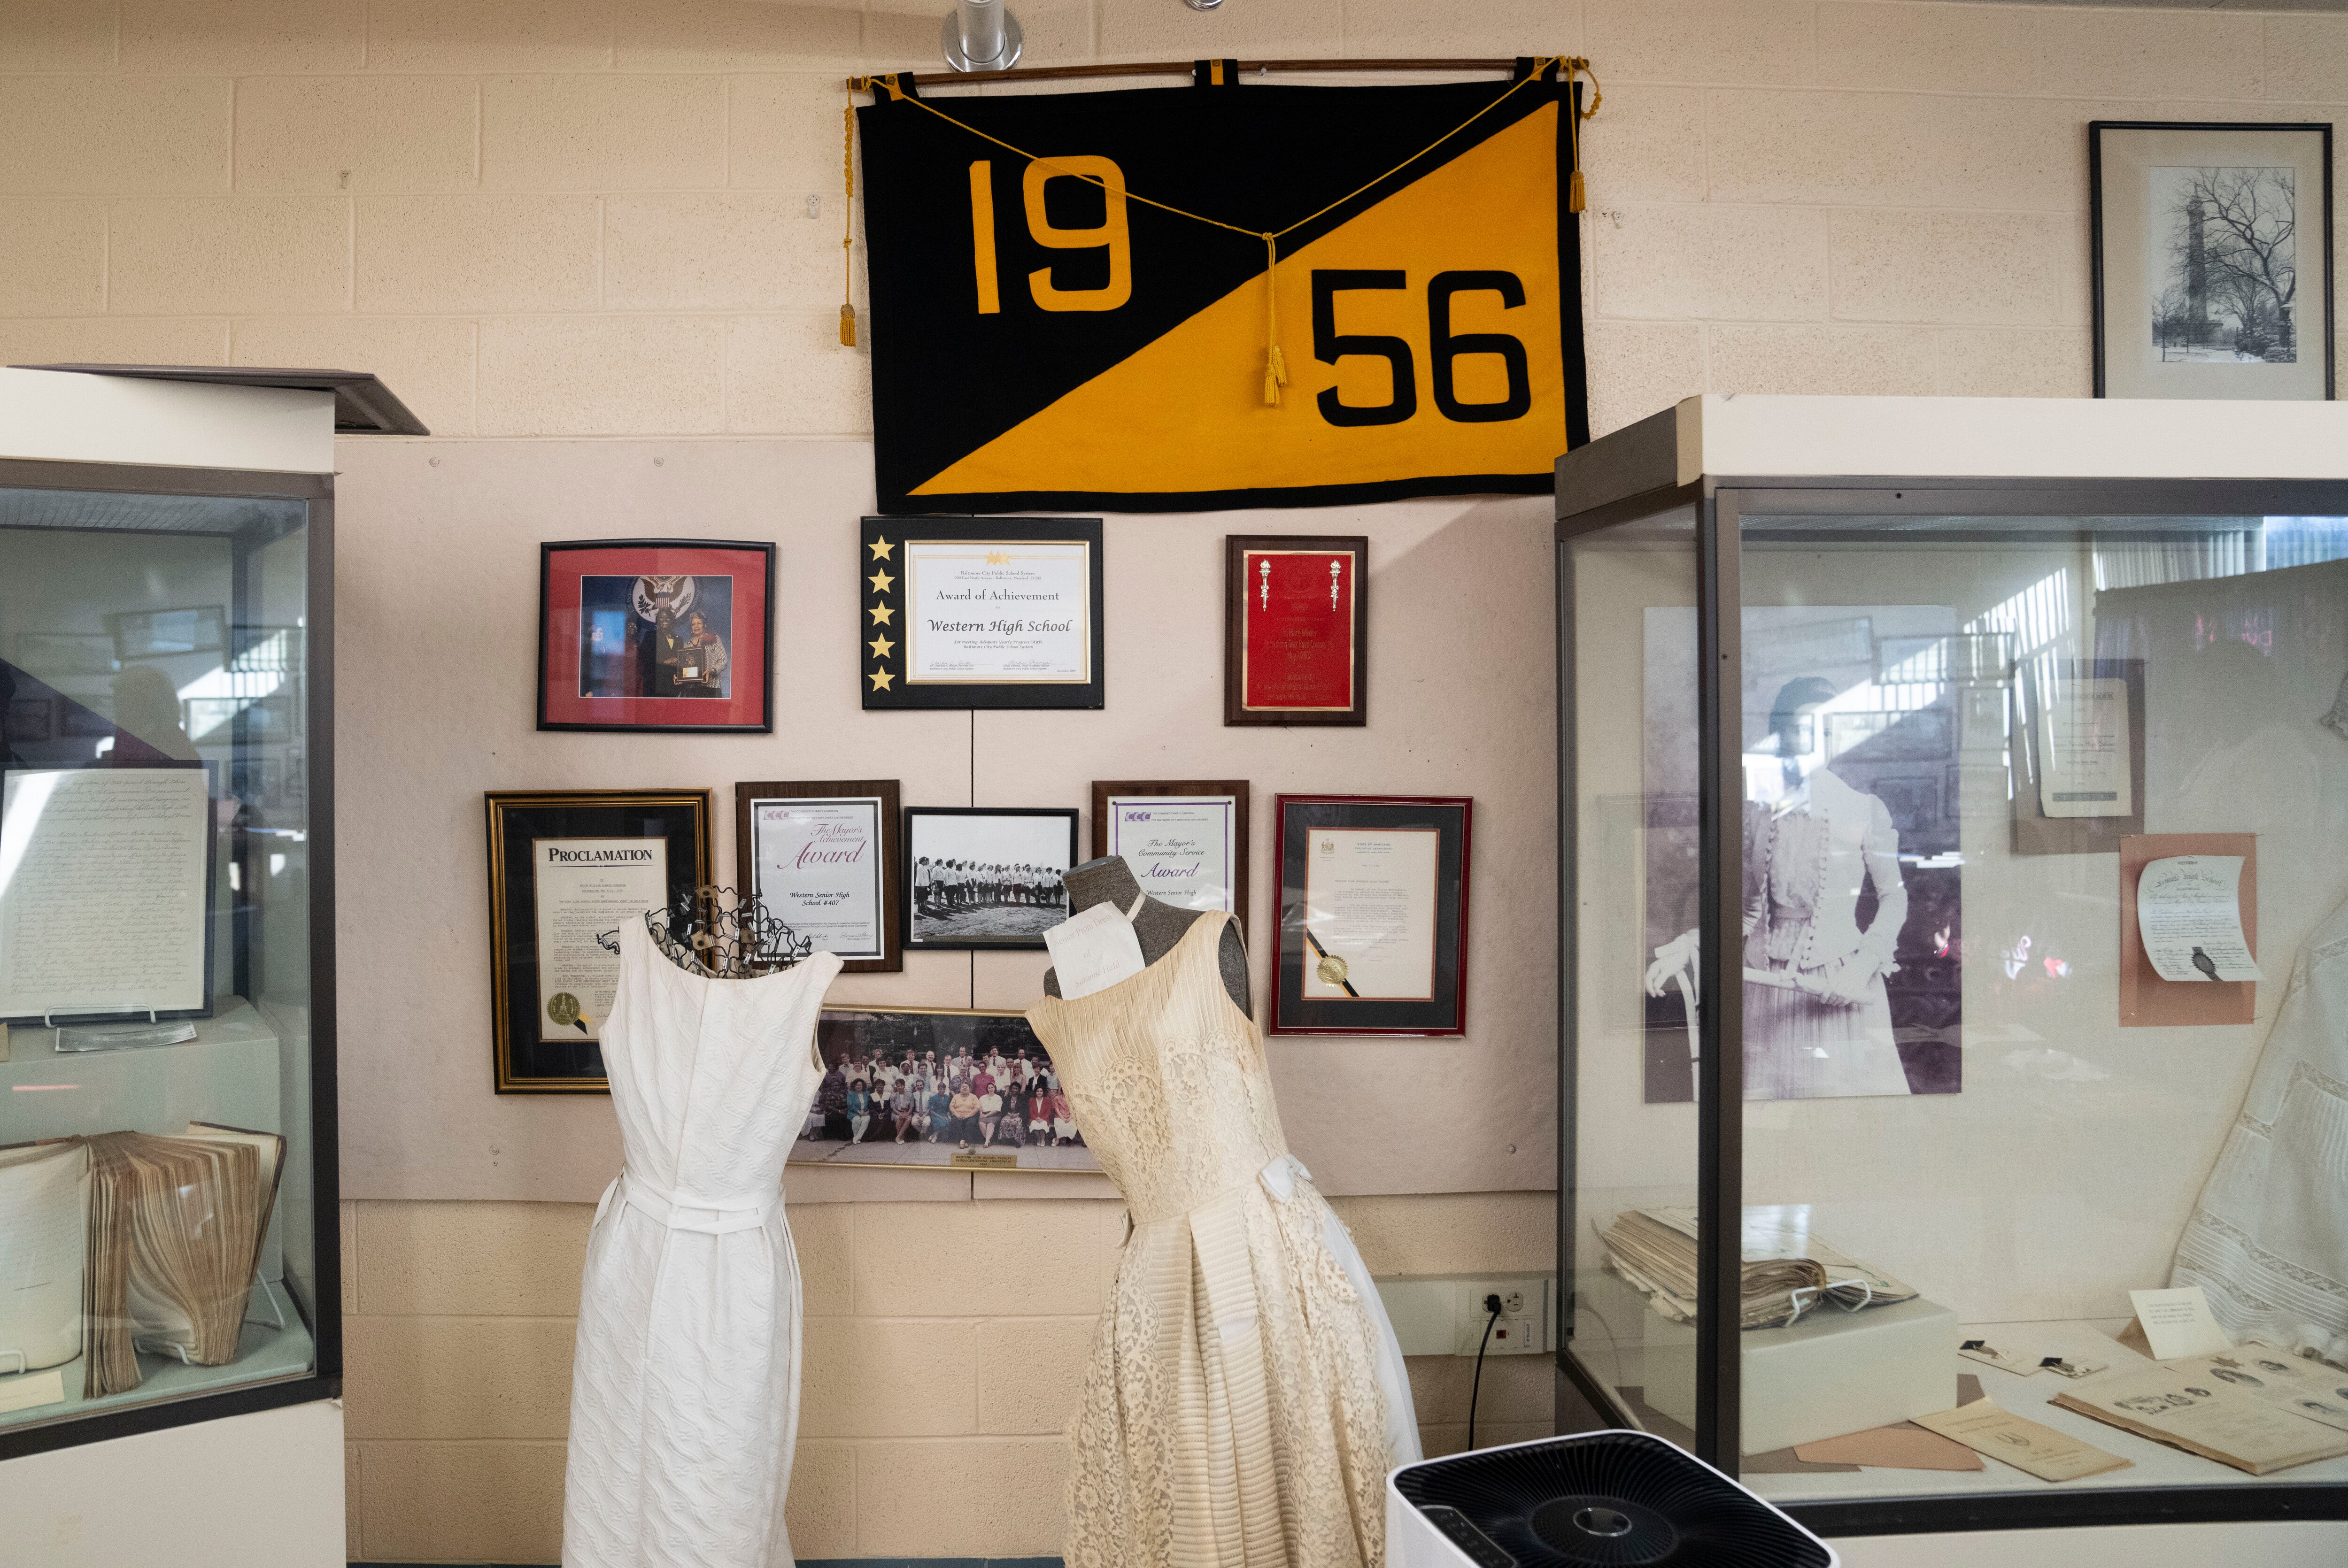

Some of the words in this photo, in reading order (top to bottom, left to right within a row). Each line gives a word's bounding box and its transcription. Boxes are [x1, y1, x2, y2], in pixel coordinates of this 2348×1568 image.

[969, 155, 1132, 315] 19
[1311, 269, 1532, 427] 56
[936, 589, 971, 600] Award
[975, 589, 986, 600] of
[989, 589, 1059, 600] Achievement
[927, 619, 984, 631] Western
[989, 620, 1023, 635] High
[1027, 620, 1073, 631] School
[1125, 812, 1151, 822] CCC
[811, 823, 830, 836] The
[827, 822, 862, 837] Mayor's
[814, 834, 864, 843] Achievement
[1165, 838, 1196, 849] Mayor's
[548, 848, 652, 862] PROCLAMATION
[777, 840, 867, 869] Award
[1138, 849, 1177, 858] Community
[1140, 862, 1200, 877] Award
[835, 891, 850, 899] High
[1054, 932, 1075, 946] Senior
[1076, 924, 1093, 936] Prom
[1093, 915, 1112, 927] Dress
[1083, 948, 1091, 959] of
[1075, 970, 1101, 986] Suzanne
[1103, 961, 1120, 974] Held
